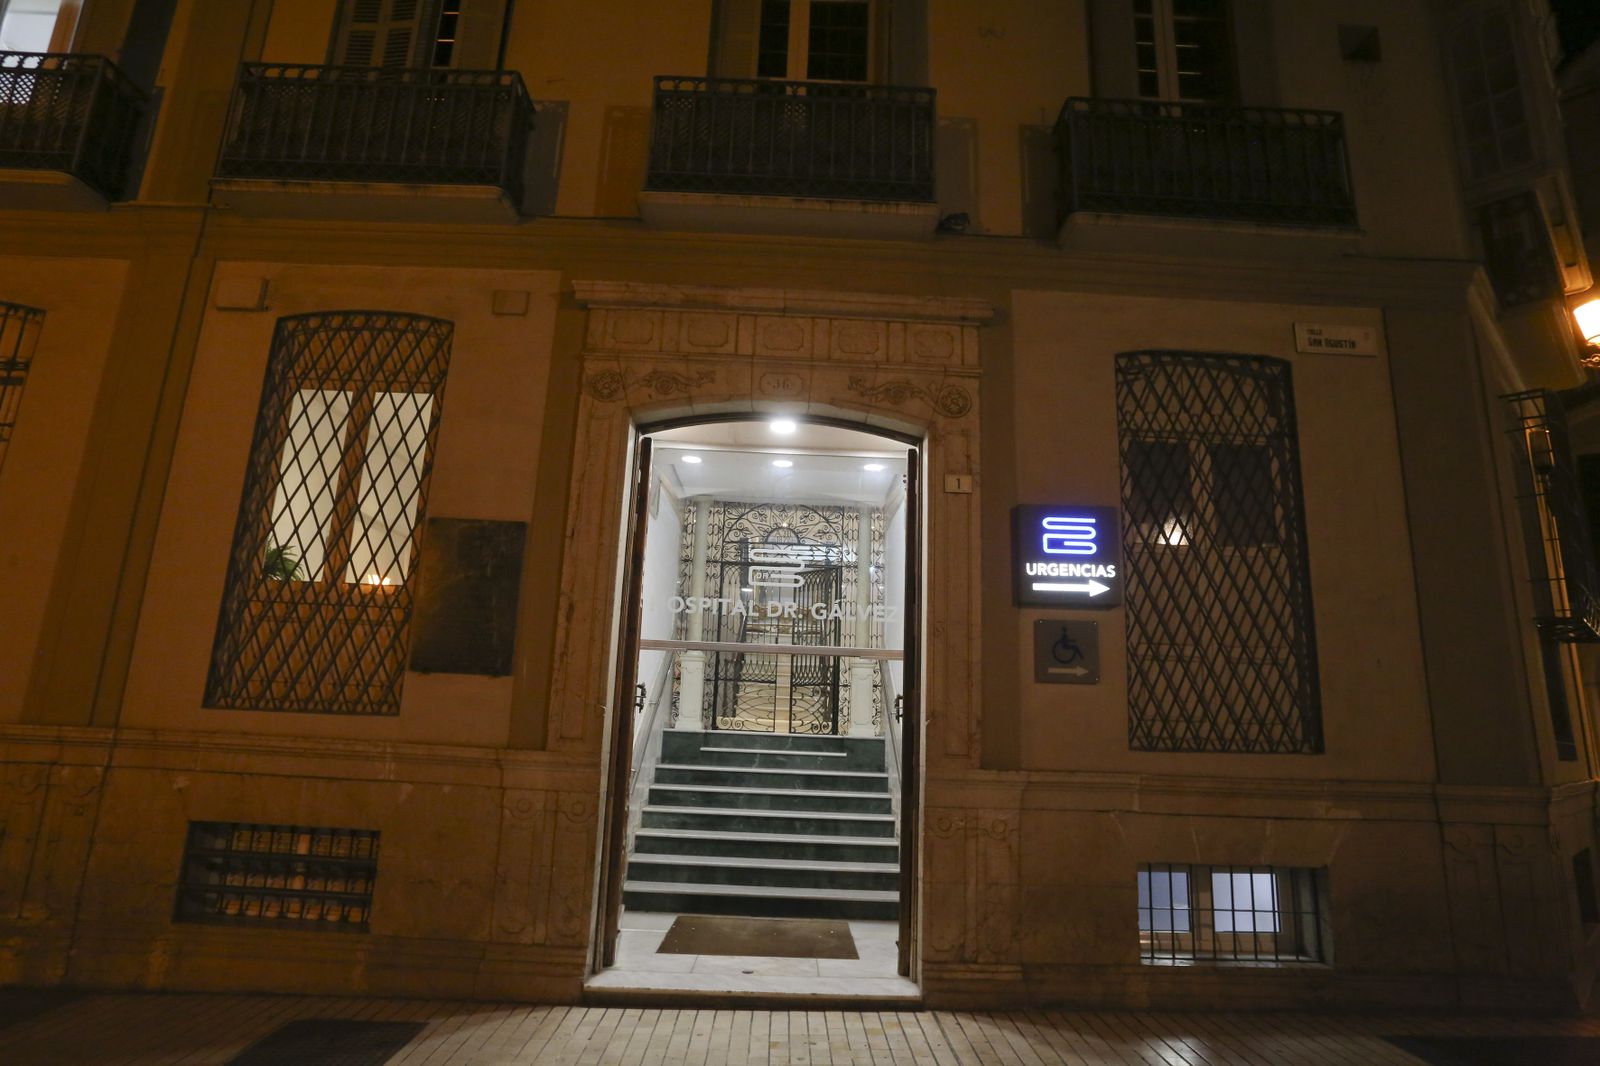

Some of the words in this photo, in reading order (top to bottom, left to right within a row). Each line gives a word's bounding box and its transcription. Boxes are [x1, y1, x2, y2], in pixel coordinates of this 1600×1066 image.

[1307, 336, 1323, 347] SAN
[956, 478, 961, 490] 1
[1026, 562, 1116, 578] URGENCIAS
[661, 596, 760, 618] OSPITAL
[767, 599, 804, 619] DR.
[811, 599, 898, 623] GÁLVEZ
